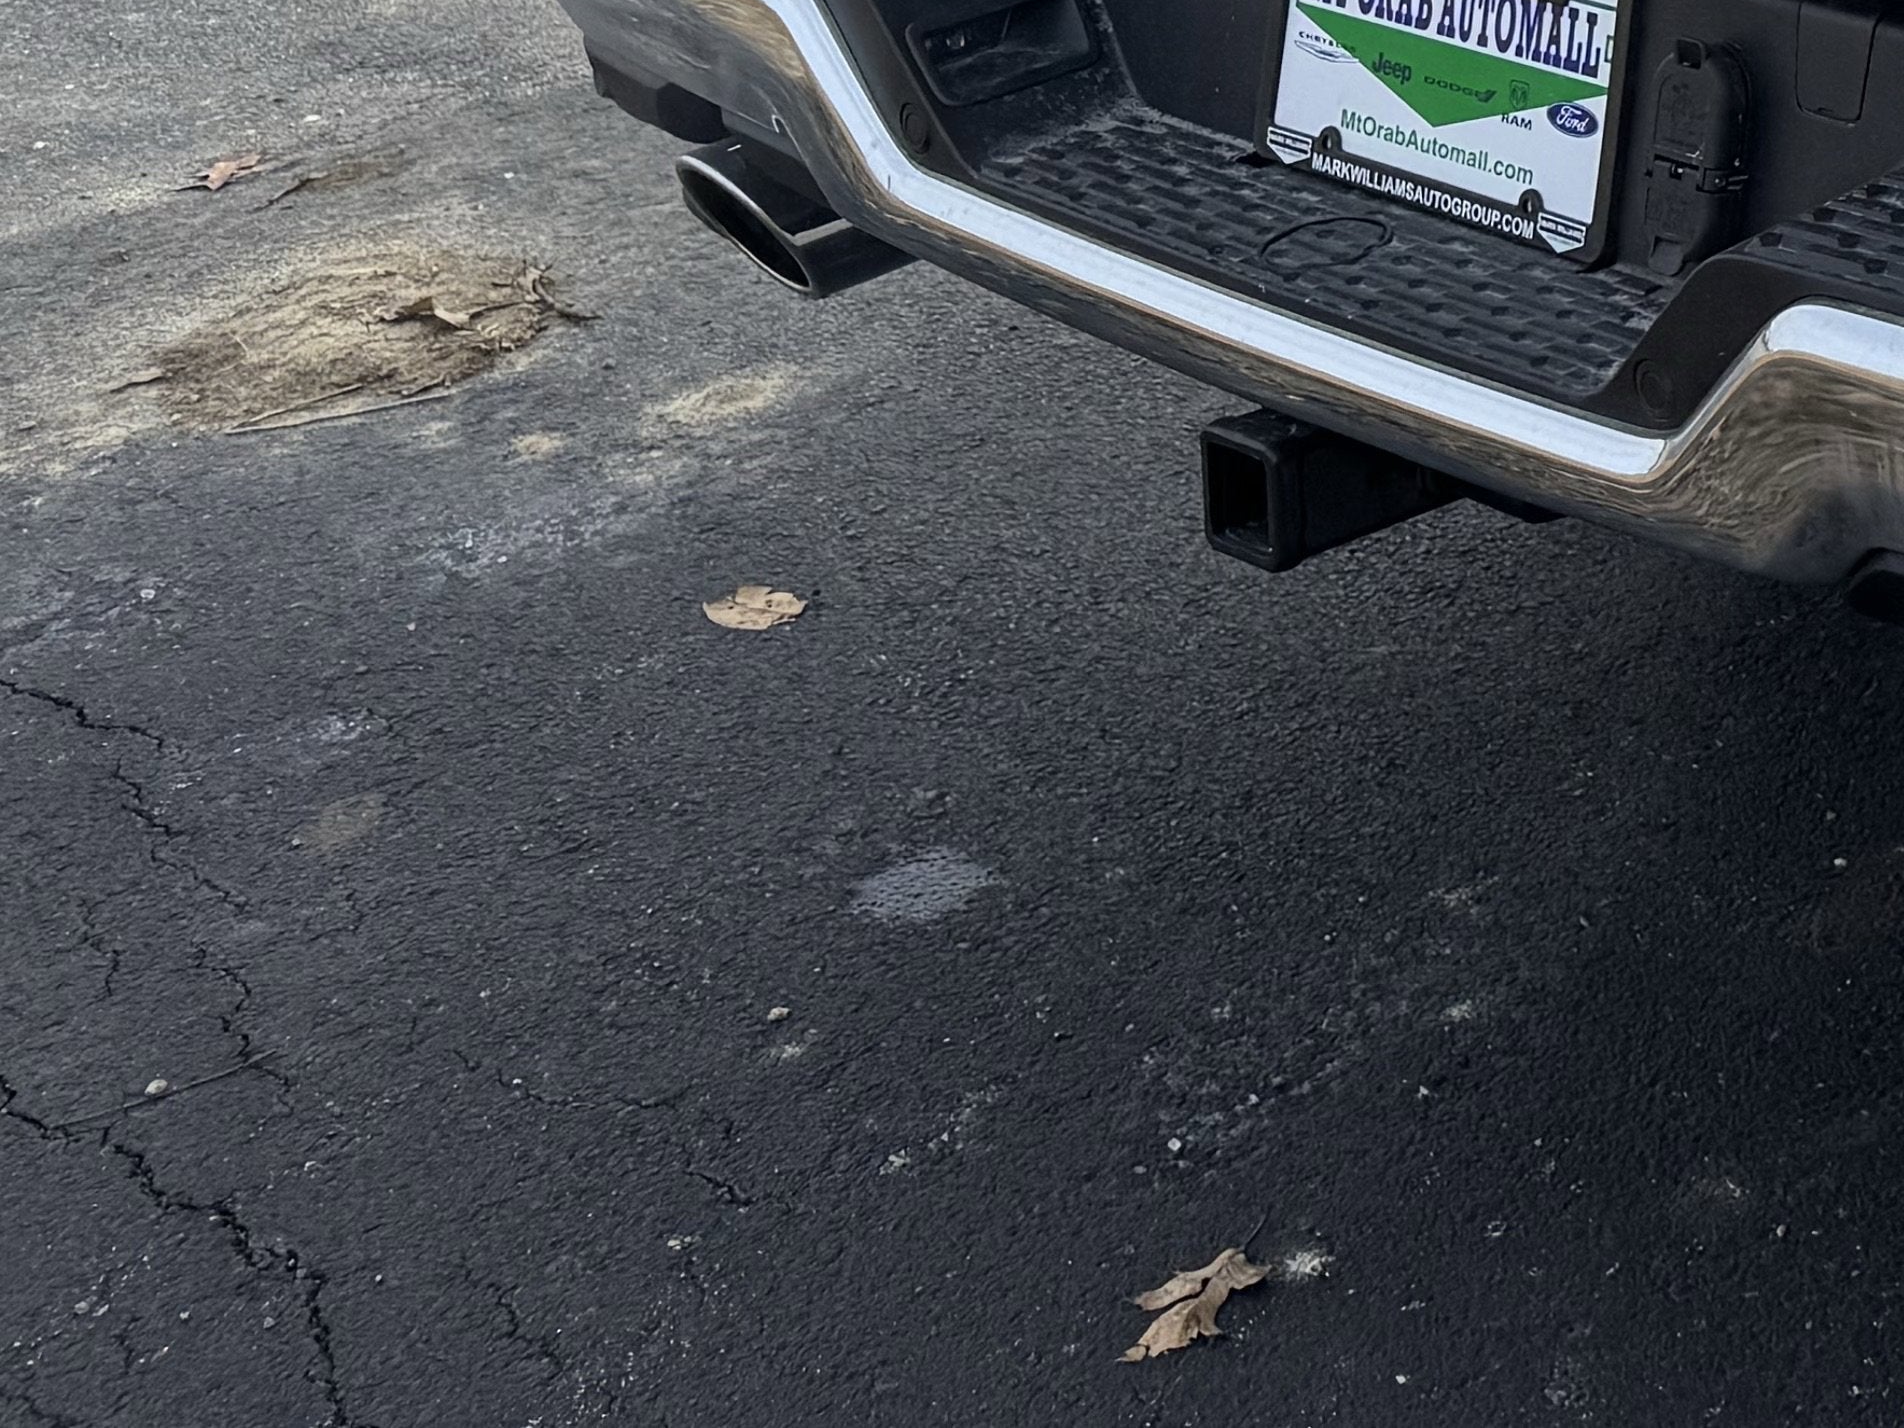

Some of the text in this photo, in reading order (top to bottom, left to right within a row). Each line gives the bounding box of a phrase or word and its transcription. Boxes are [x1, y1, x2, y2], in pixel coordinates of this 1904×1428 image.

[1372, 52, 1412, 85] Jeep
[1500, 113, 1532, 131] RAM
[1556, 105, 1590, 132] Ford
[1340, 108, 1533, 186] MtOrabAutomall.com
[1311, 151, 1535, 240] MARKWILLIAMSAUTOGROUP.COM
